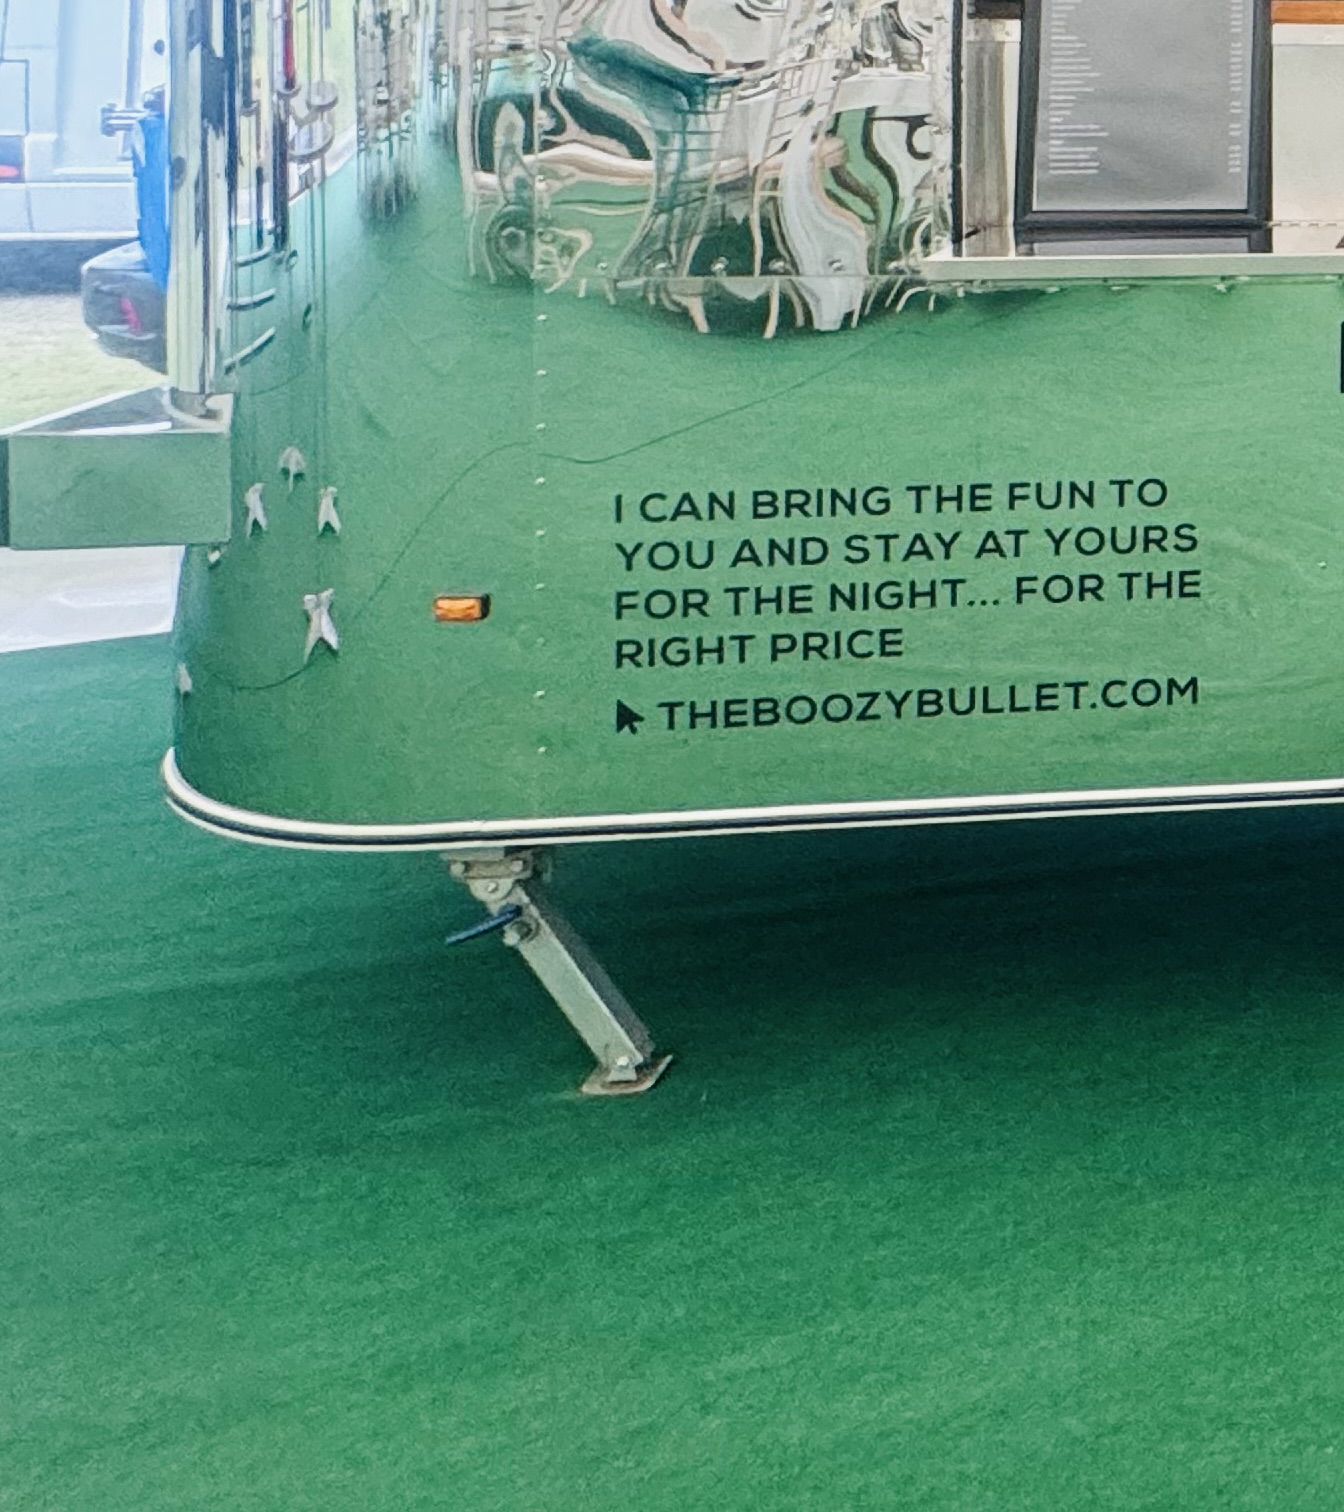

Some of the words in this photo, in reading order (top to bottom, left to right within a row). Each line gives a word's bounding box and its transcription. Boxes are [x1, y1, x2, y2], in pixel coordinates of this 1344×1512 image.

[615, 494, 623, 524] I
[639, 490, 735, 523] CAN
[752, 485, 891, 520] BRING
[905, 482, 993, 514] THE
[1008, 480, 1095, 511] FUN
[1108, 478, 1168, 508] TO
[615, 539, 714, 572] YOU
[729, 536, 829, 568] AND
[844, 530, 962, 565] STAY
[974, 529, 1030, 560] AT
[1043, 523, 1198, 557] YOURS
[615, 588, 710, 620] FOR
[723, 584, 814, 617] THE
[829, 578, 1000, 612] NIGHT...
[1015, 573, 1105, 605] FOR
[1117, 569, 1202, 601] THE
[615, 634, 756, 669] RIGHT
[770, 628, 904, 663] PRICE
[656, 676, 1199, 731] THEBOOZYBULLET.COM
